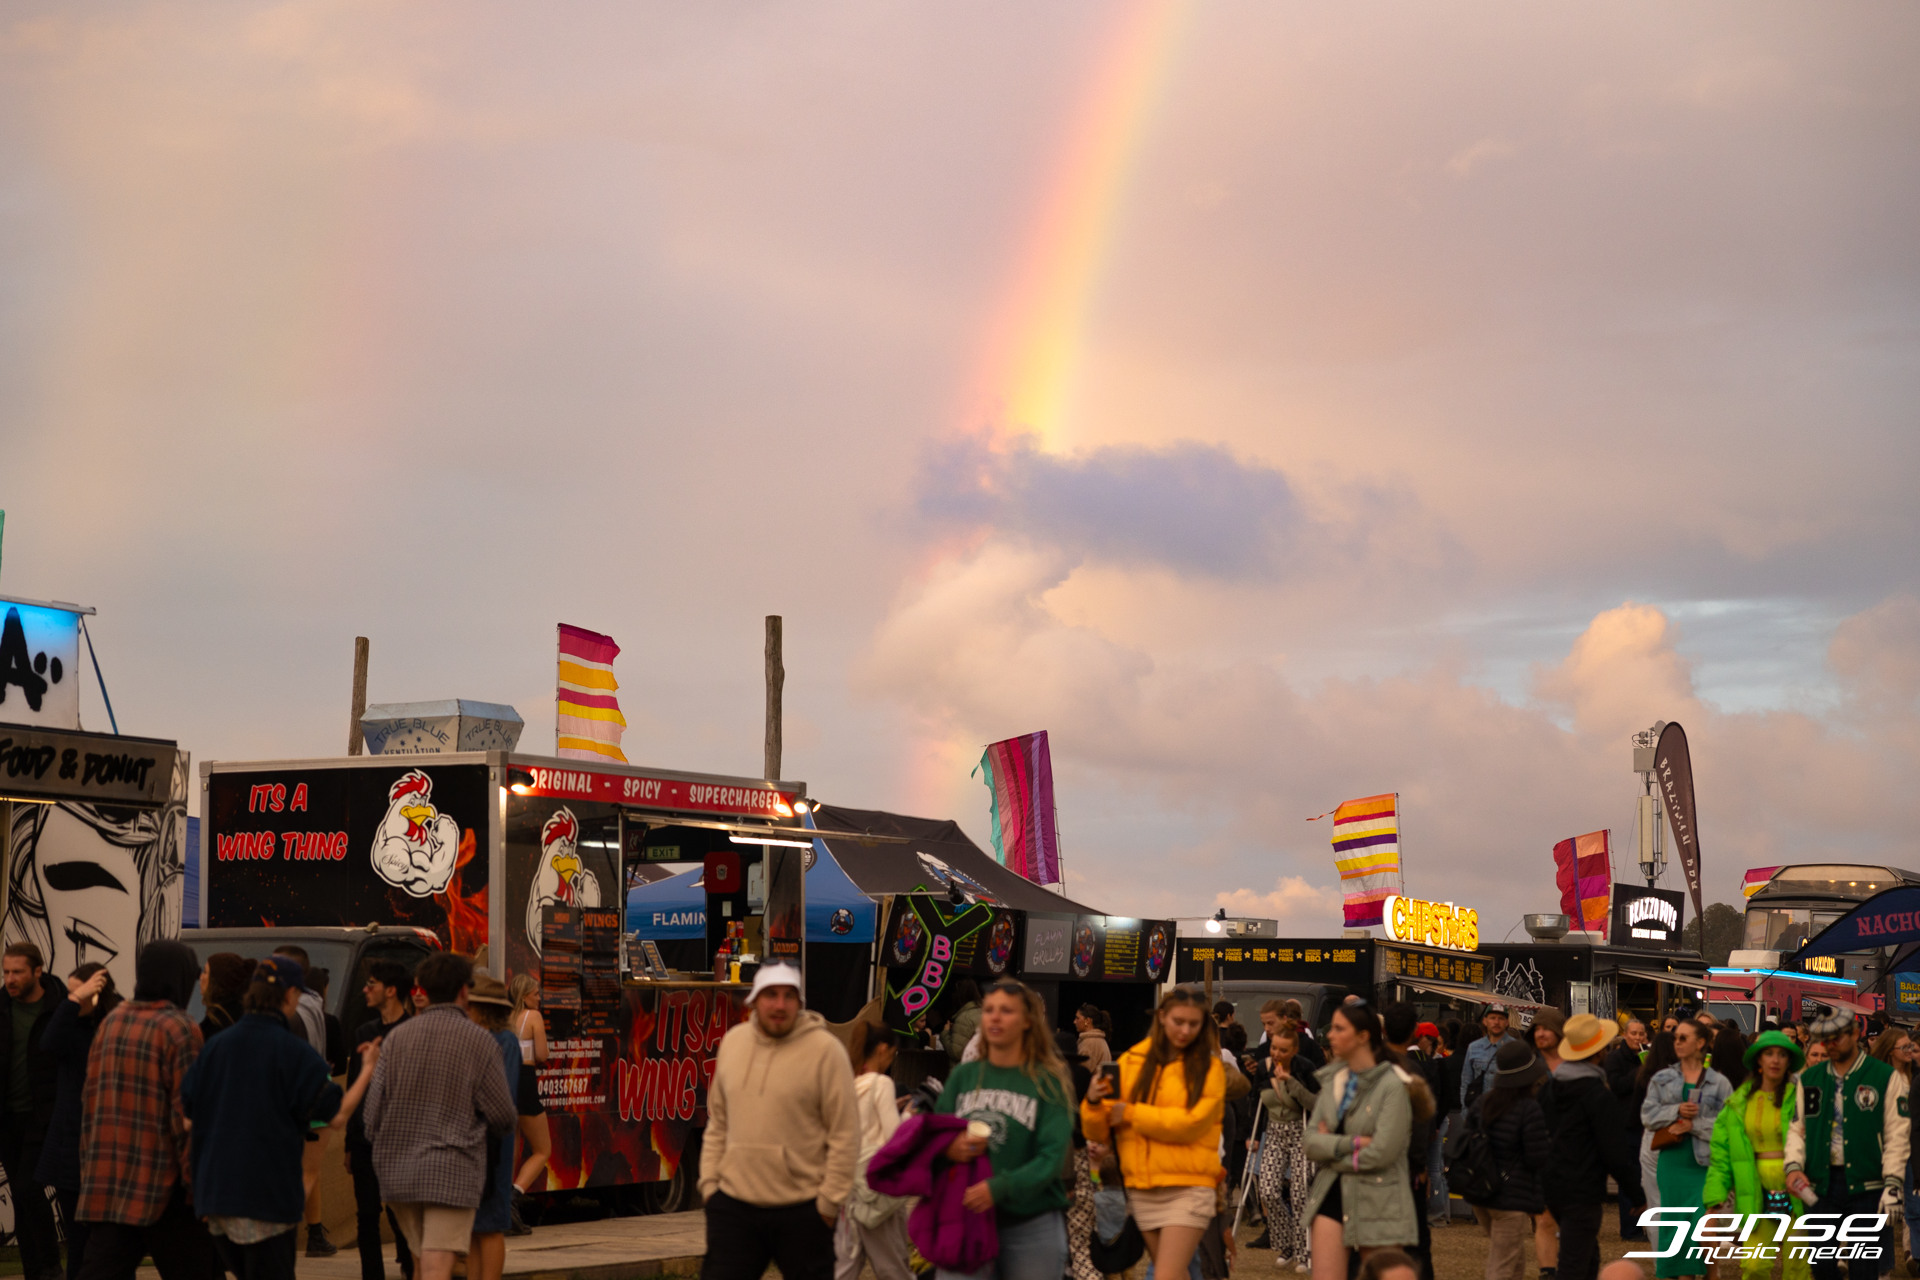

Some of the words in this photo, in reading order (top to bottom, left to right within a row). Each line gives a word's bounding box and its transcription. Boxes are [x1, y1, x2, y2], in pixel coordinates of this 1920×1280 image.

[374, 718, 408, 744] TRUE
[413, 718, 450, 745] BLUE
[465, 719, 492, 741] TRUE
[494, 719, 513, 749] BLUE
[81, 753, 156, 791] DONUT
[249, 783, 286, 813] ITS
[290, 782, 308, 812] A
[623, 778, 661, 800] SPICY
[689, 784, 781, 811] SUPERCHARGED
[217, 831, 276, 861] WING
[281, 831, 348, 861] THING
[652, 848, 675, 858] EXIT
[584, 913, 618, 928] WINGS
[773, 942, 799, 953] LOADED
[657, 990, 706, 1052] ITS
[538, 1078, 588, 1096] 0403567687
[618, 1057, 698, 1121] WING
[1805, 1086, 1823, 1118] B
[955, 1088, 1038, 1132] CALIFORNIA
